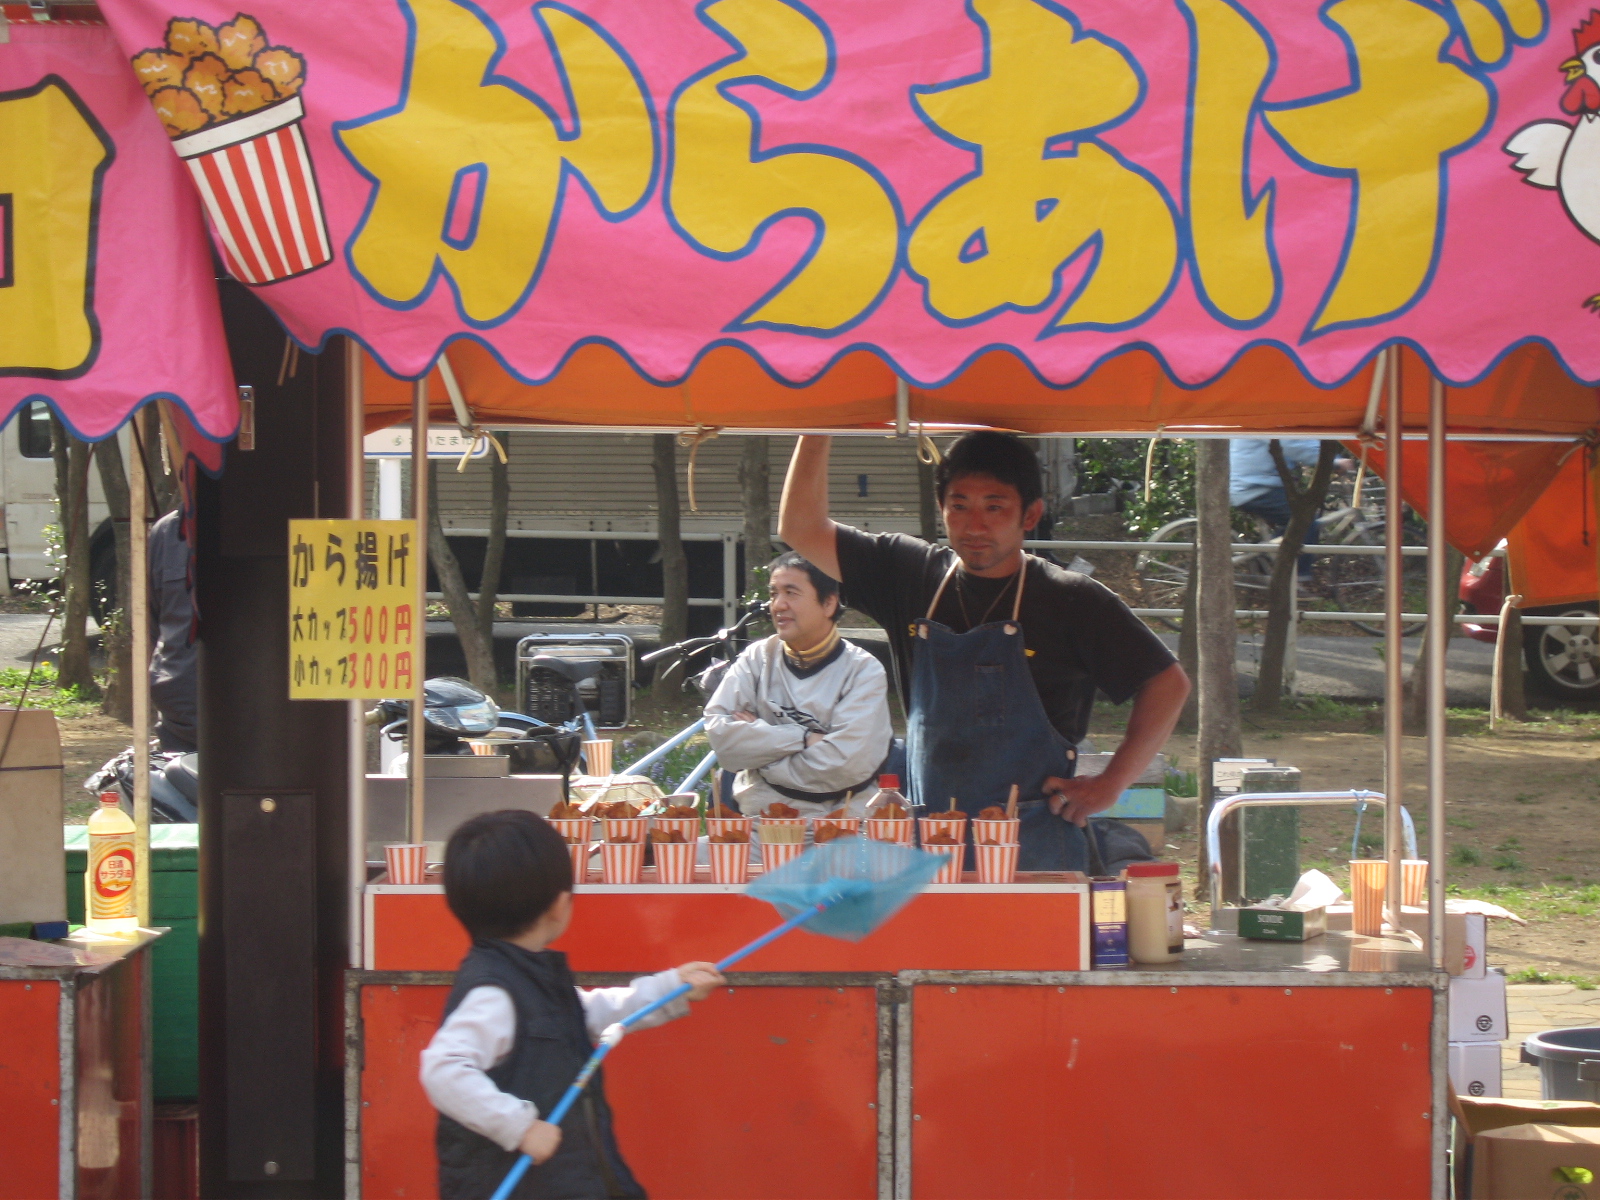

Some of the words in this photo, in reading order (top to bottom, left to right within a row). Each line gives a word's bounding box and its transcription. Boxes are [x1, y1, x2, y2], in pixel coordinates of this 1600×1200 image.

[332, 0, 1548, 344] からあげ
[293, 531, 410, 590] から揚げ
